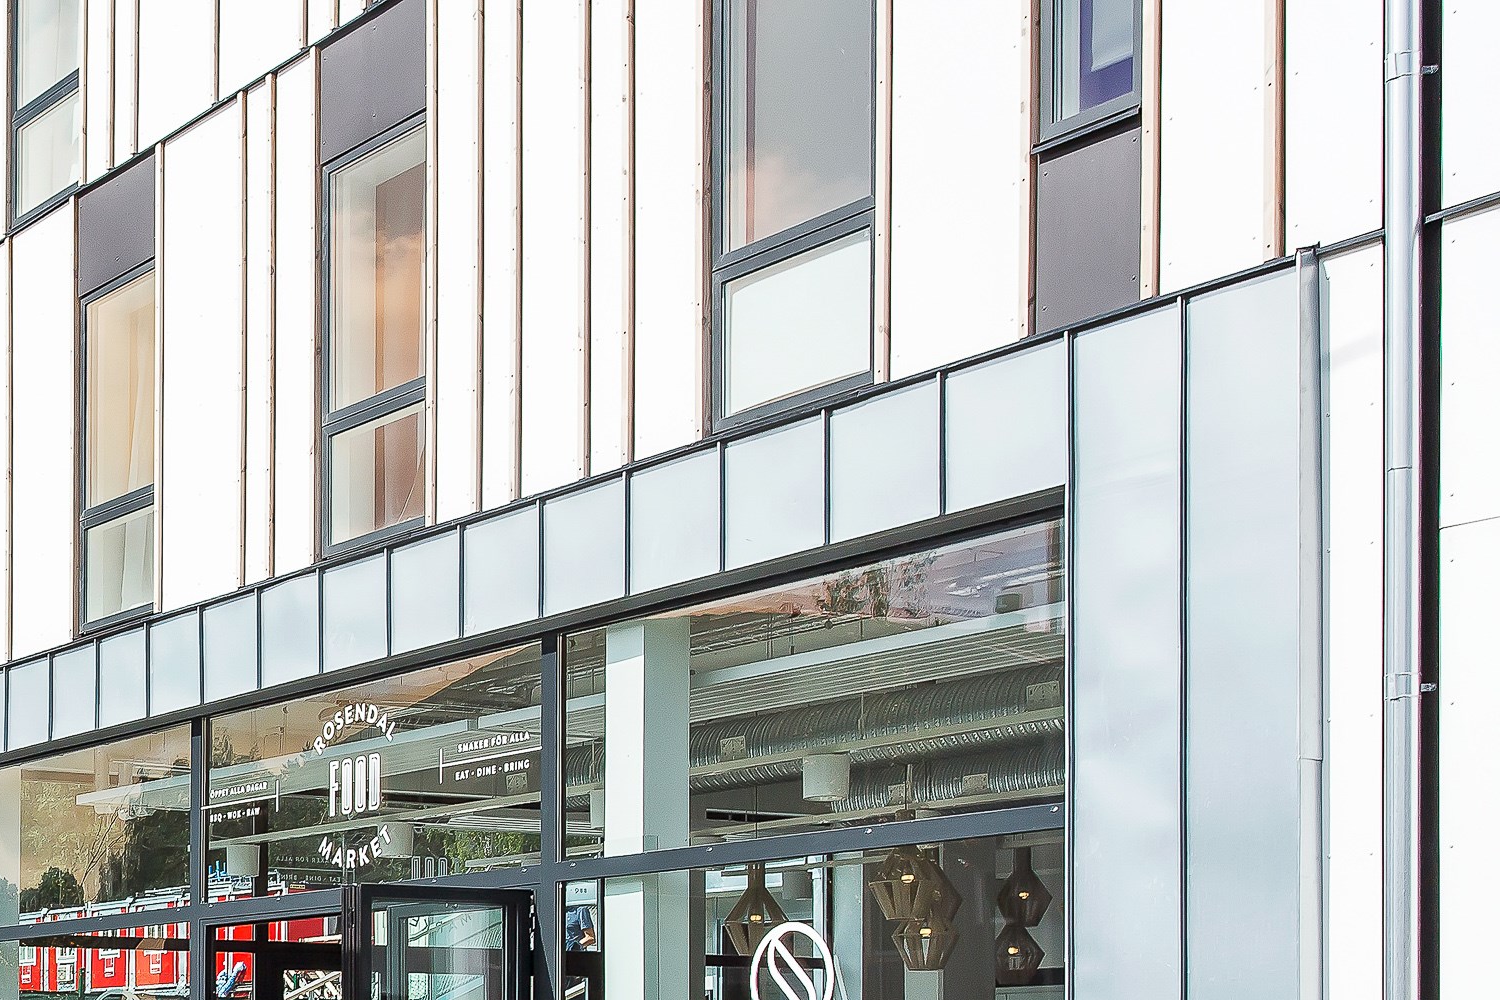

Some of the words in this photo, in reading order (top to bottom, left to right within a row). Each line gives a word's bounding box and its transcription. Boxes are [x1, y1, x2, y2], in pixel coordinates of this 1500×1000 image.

[313, 702, 396, 756] ROSENDAL
[457, 738, 489, 753] SMAKER
[491, 734, 508, 747] FÖR
[509, 731, 530, 744] ALLA
[455, 769, 470, 781] EAT
[476, 765, 497, 777] DINE
[503, 759, 530, 773] BRING
[230, 785, 245, 795] ALLA
[246, 781, 268, 793] DAGAR
[329, 752, 381, 817] FOOD
[227, 810, 241, 819] WOK
[318, 825, 391, 868] MARKET
